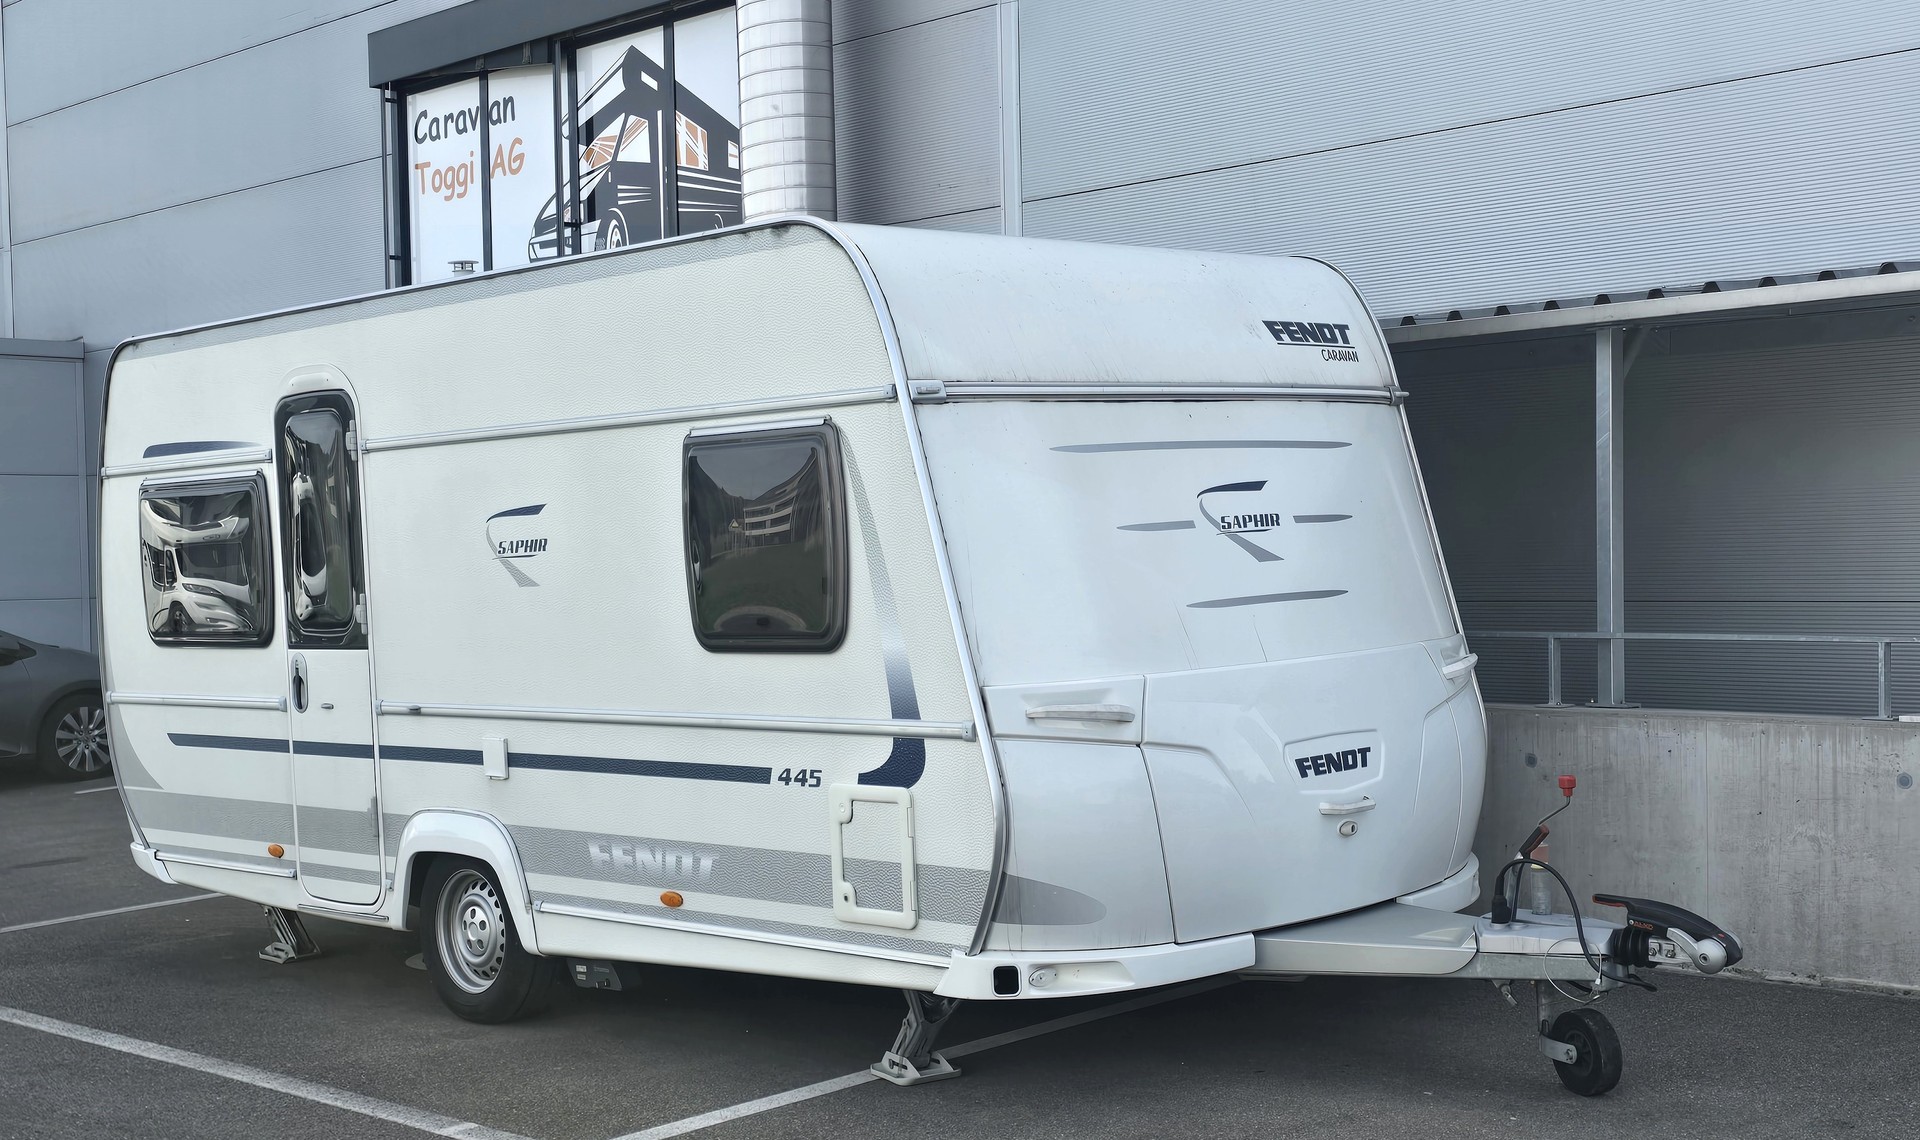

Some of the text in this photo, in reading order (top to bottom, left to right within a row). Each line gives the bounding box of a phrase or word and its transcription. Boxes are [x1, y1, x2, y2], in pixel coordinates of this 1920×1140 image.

[414, 95, 515, 144] Caravan
[415, 137, 525, 202] Toggi AG
[1261, 319, 1351, 345] FENDT
[1321, 349, 1359, 362] CARAVAN
[1220, 513, 1280, 530] SAPHIR
[497, 538, 548, 555] SAPHIR
[1295, 746, 1371, 779] FENDT
[777, 768, 822, 788] 445
[588, 840, 720, 880] FENDT
